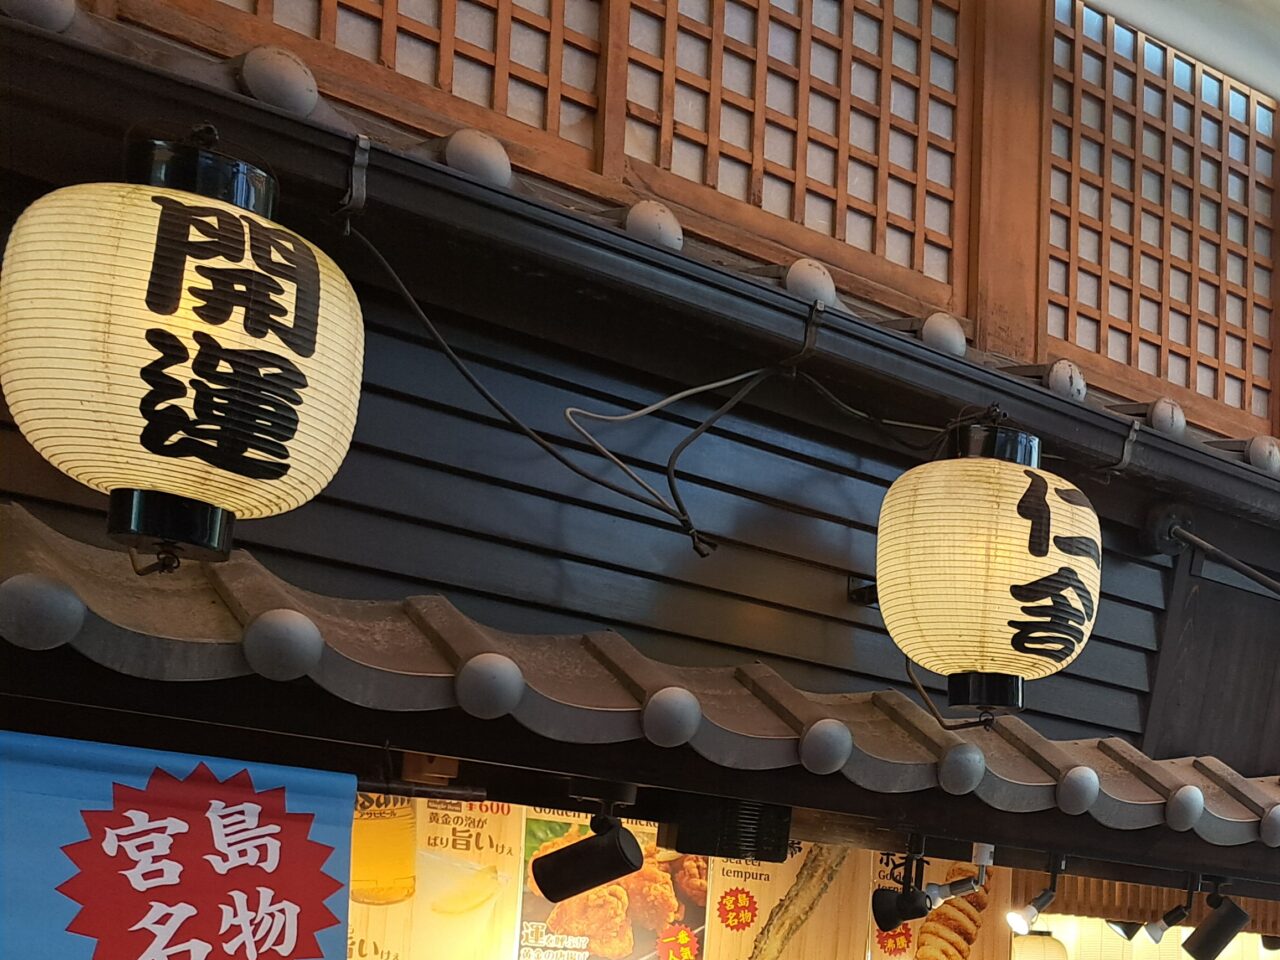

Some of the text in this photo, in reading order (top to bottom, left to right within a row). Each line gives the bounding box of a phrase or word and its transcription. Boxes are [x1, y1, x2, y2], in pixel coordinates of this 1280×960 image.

[138, 195, 320, 480] 開運
[1008, 470, 1100, 663] 仁舎
[429, 812, 487, 829] 黄金の泡が
[102, 800, 283, 891] 宮島
[722, 866, 770, 882] tempura
[723, 893, 750, 911] 宮島
[726, 911, 752, 927] 名物
[661, 930, 690, 944] 一番
